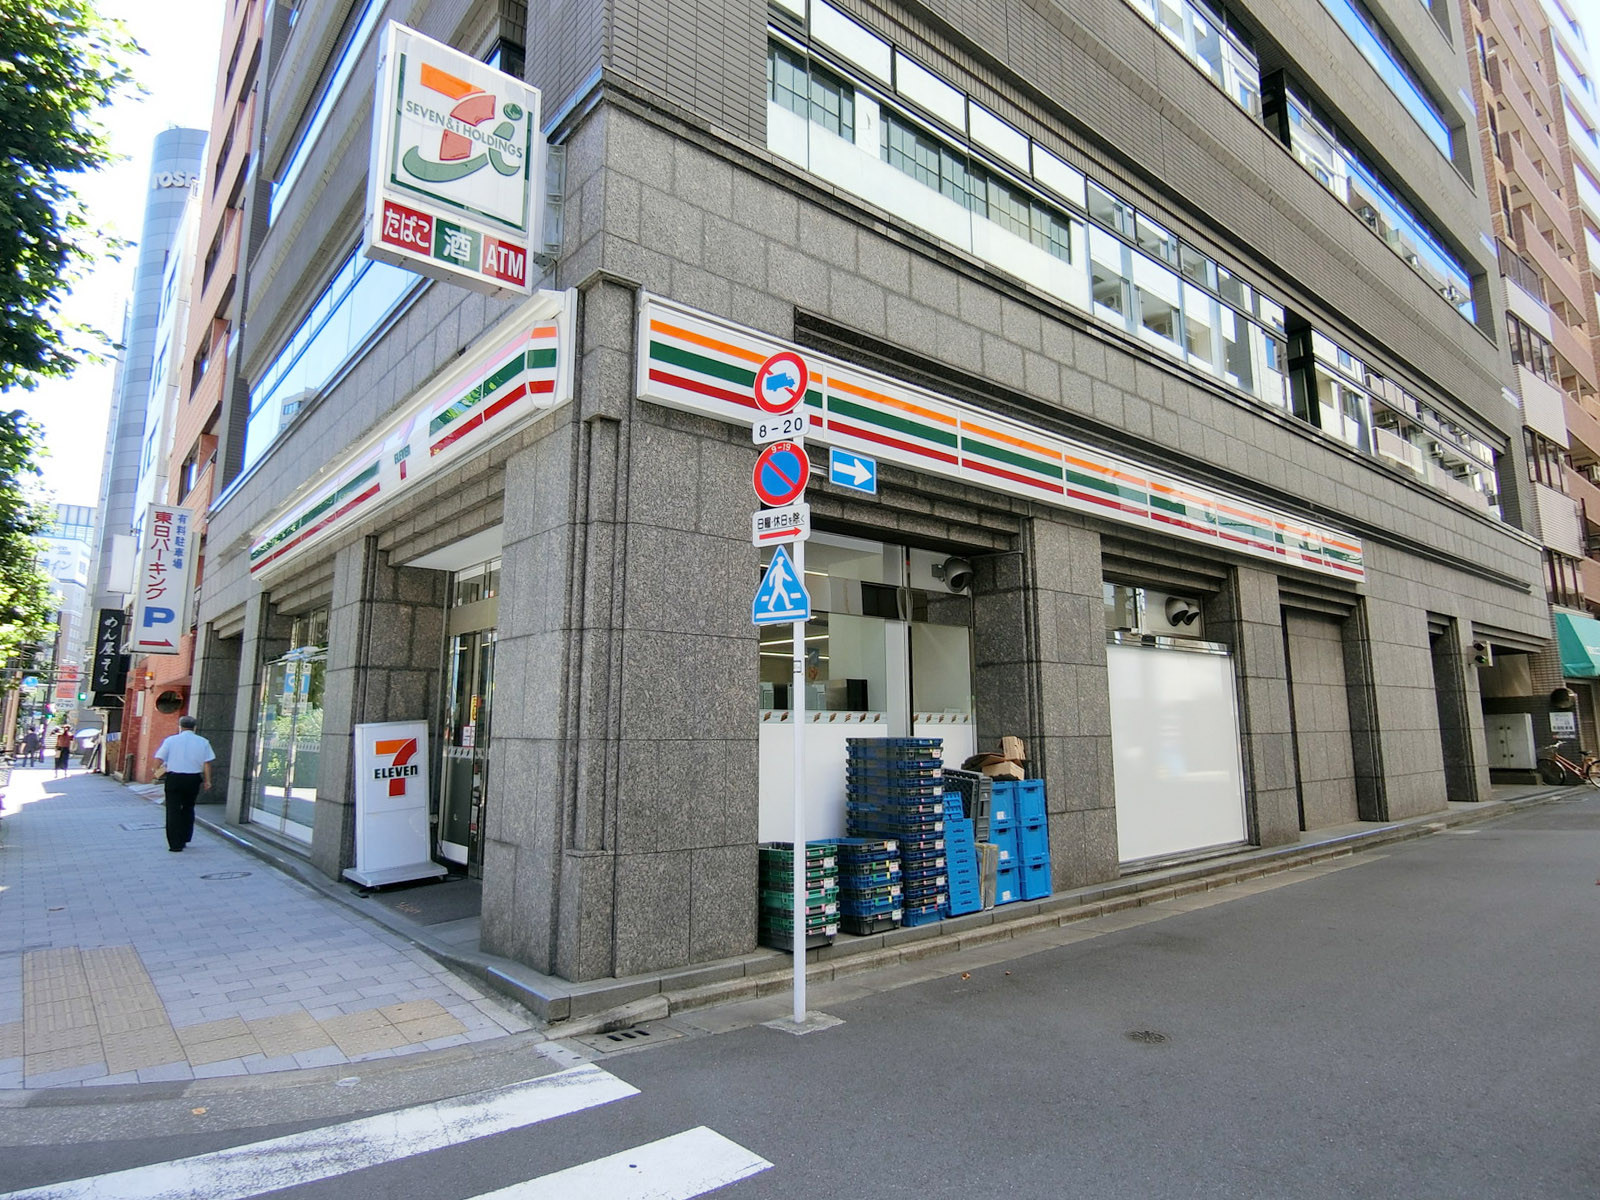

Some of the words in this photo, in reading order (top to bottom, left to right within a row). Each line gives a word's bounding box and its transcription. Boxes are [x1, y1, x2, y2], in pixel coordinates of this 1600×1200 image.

[463, 124, 523, 158] HOLDINGS
[383, 208, 430, 248] たばこ
[443, 227, 472, 262] 酒
[485, 244, 524, 280] ATM
[770, 443, 791, 454] 9-19
[172, 514, 189, 570] 有料駐車場
[143, 606, 175, 627] P
[99, 616, 119, 685] めん屋そら
